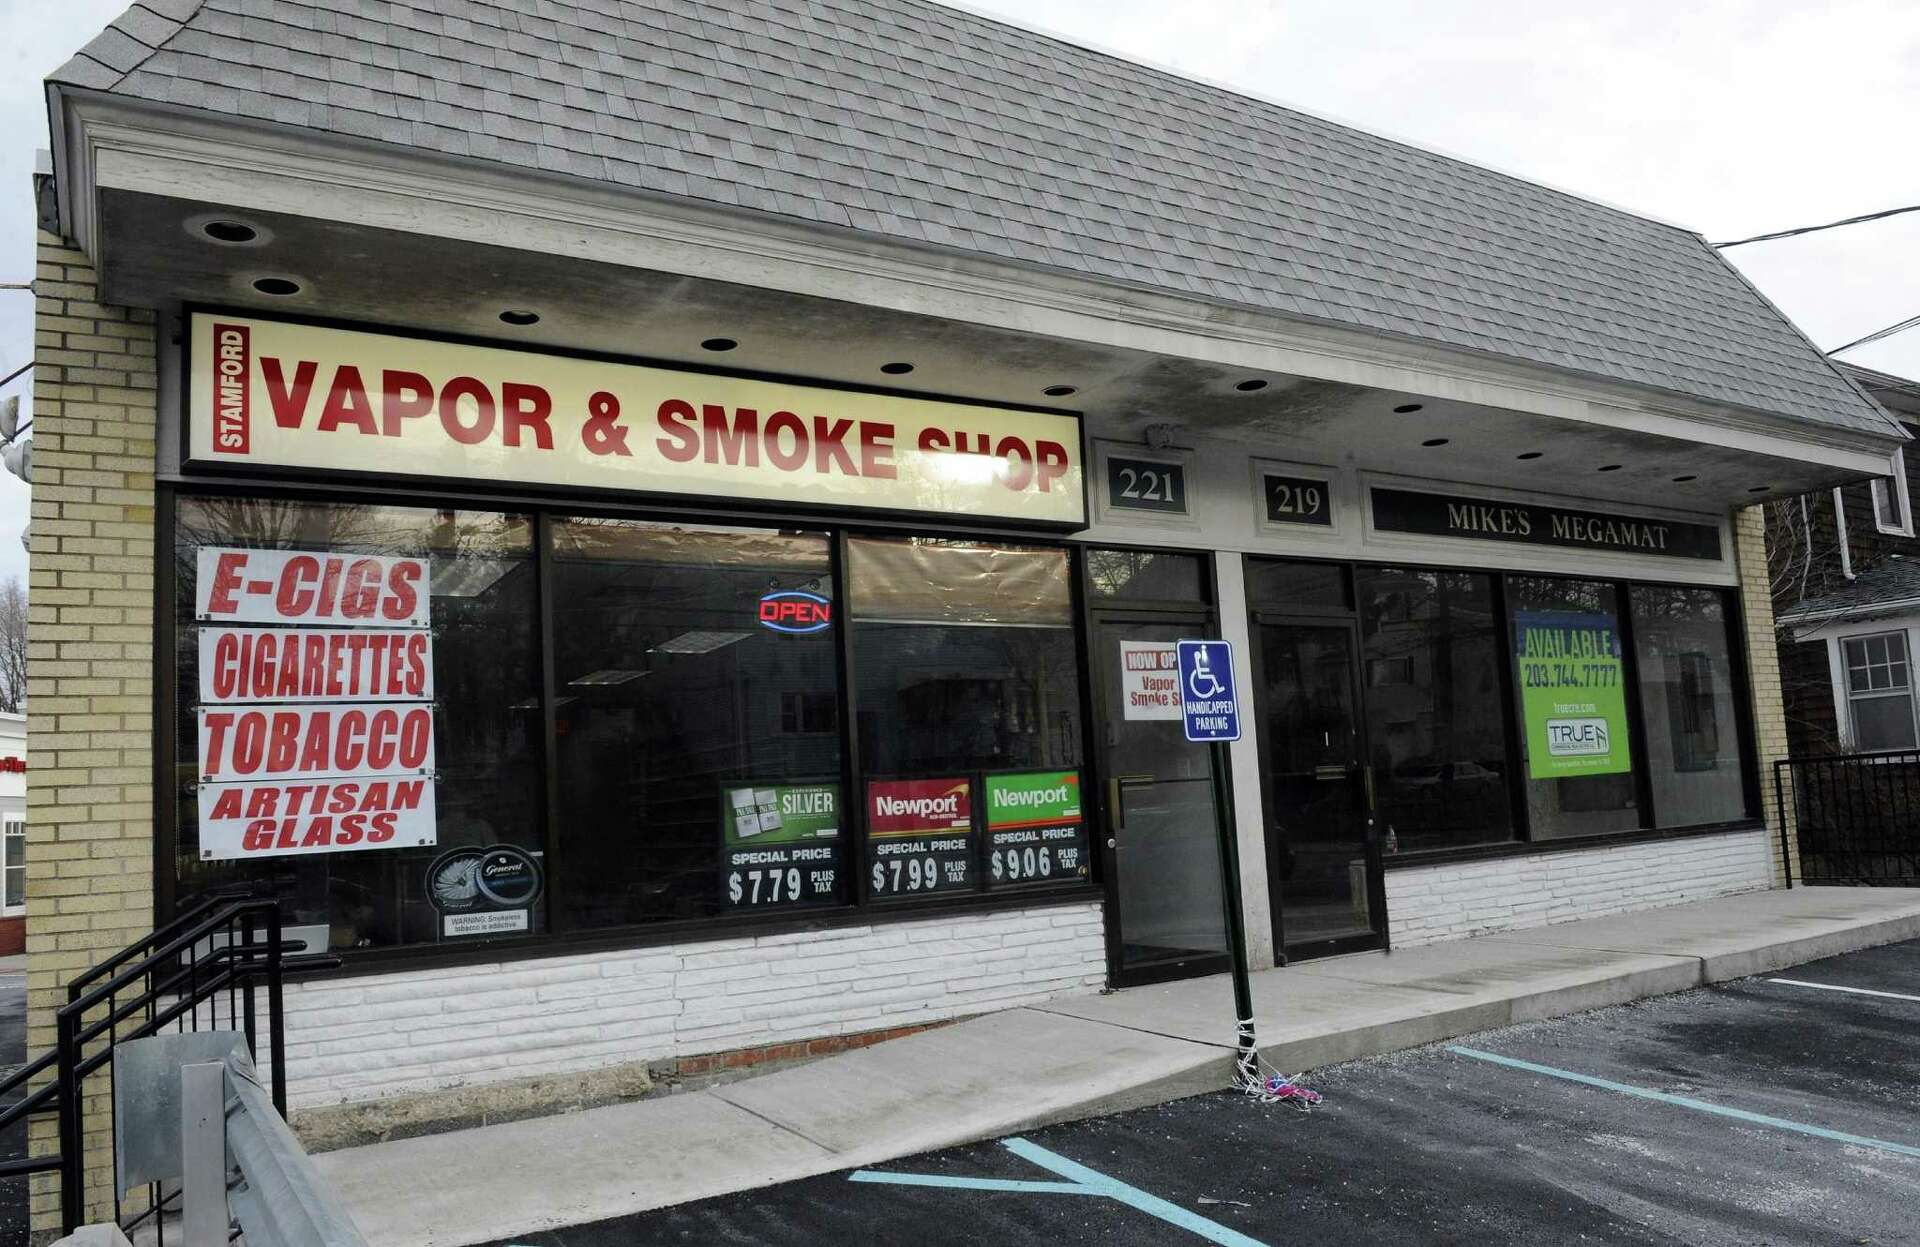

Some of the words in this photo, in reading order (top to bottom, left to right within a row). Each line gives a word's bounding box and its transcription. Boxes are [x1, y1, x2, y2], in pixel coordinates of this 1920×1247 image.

[219, 330, 244, 448] STAMFORD
[259, 356, 555, 451] VAPOR
[580, 391, 633, 457] &
[656, 399, 898, 480] SMOKE
[1119, 468, 1175, 502] 221
[1275, 485, 1321, 516] 219
[1447, 503, 1531, 536] MIKE'S
[1551, 514, 1669, 549] MEGAMAT
[207, 552, 422, 621] E-CIGS
[760, 602, 830, 622] OPEN
[1525, 628, 1612, 660] AVAILABLE
[213, 632, 427, 699] CIGARETTES
[1128, 652, 1157, 670] NOW
[1160, 651, 1177, 669] OP
[1142, 676, 1175, 691] Vapor
[1524, 663, 1617, 688] 203.744.7777
[1131, 692, 1169, 706] Smoke
[1186, 701, 1234, 715] HANDICAPPED
[1196, 716, 1229, 731] PARKING
[1549, 724, 1595, 742] TRUE
[204, 709, 431, 775] TOBACCO
[209, 780, 425, 820] ARTISAN
[782, 792, 833, 815] SILVER
[876, 794, 958, 818] Newport
[993, 785, 1068, 808] Newport
[242, 812, 398, 851] GLASS
[993, 831, 1040, 844] SPECIAL
[1042, 827, 1075, 840] PRICE
[732, 851, 788, 865] SPECIAL
[792, 848, 831, 861] PRICE
[877, 842, 927, 855] SPECIAL
[931, 839, 966, 851] PRICE
[1058, 848, 1078, 859] PLUS
[485, 863, 524, 876] General
[872, 857, 937, 892] $7.99
[944, 861, 966, 872] PLUS
[991, 846, 1051, 880] $9.06
[1061, 859, 1077, 869] TAX
[729, 867, 801, 904] $7.79
[810, 870, 834, 882] PLUS
[813, 881, 832, 893] TAX
[947, 871, 964, 882] TAX
